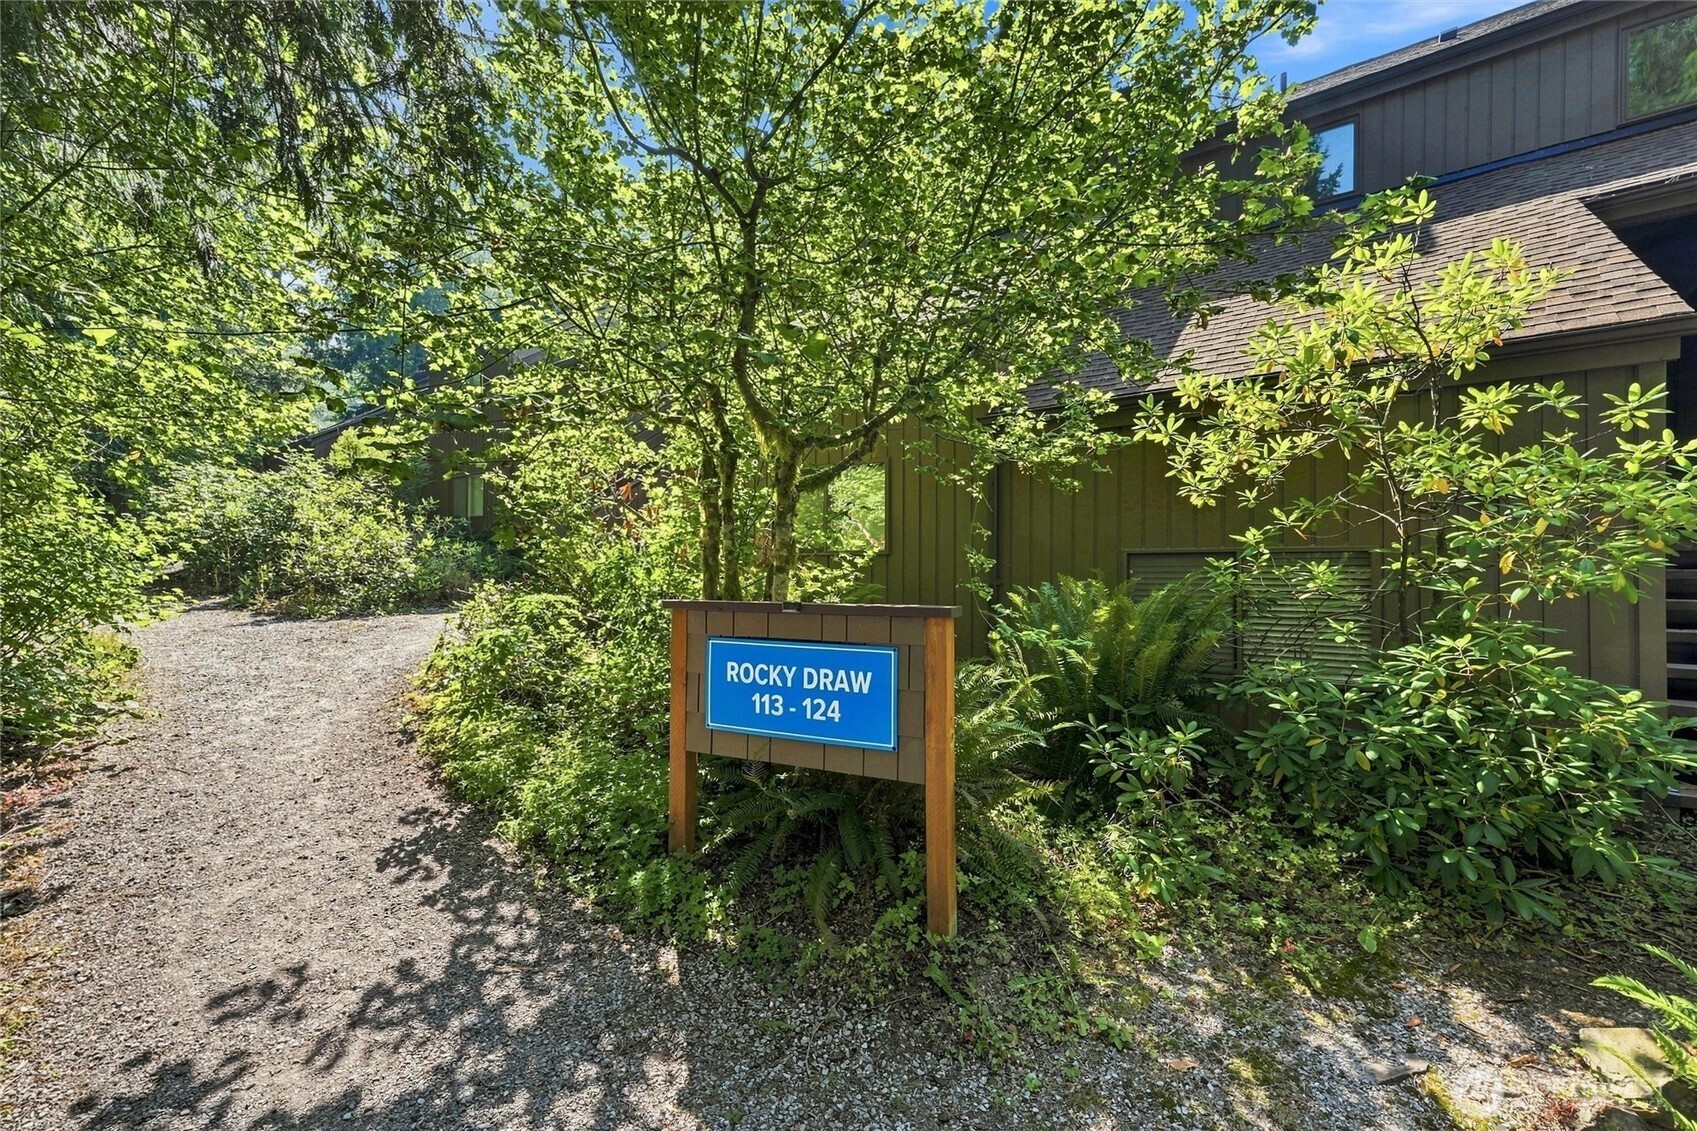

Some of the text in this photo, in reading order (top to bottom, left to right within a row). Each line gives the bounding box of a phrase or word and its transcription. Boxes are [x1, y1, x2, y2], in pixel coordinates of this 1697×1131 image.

[726, 661, 872, 694] ROCKY DRAW
[752, 693, 784, 716] 113
[802, 698, 841, 722] 124
